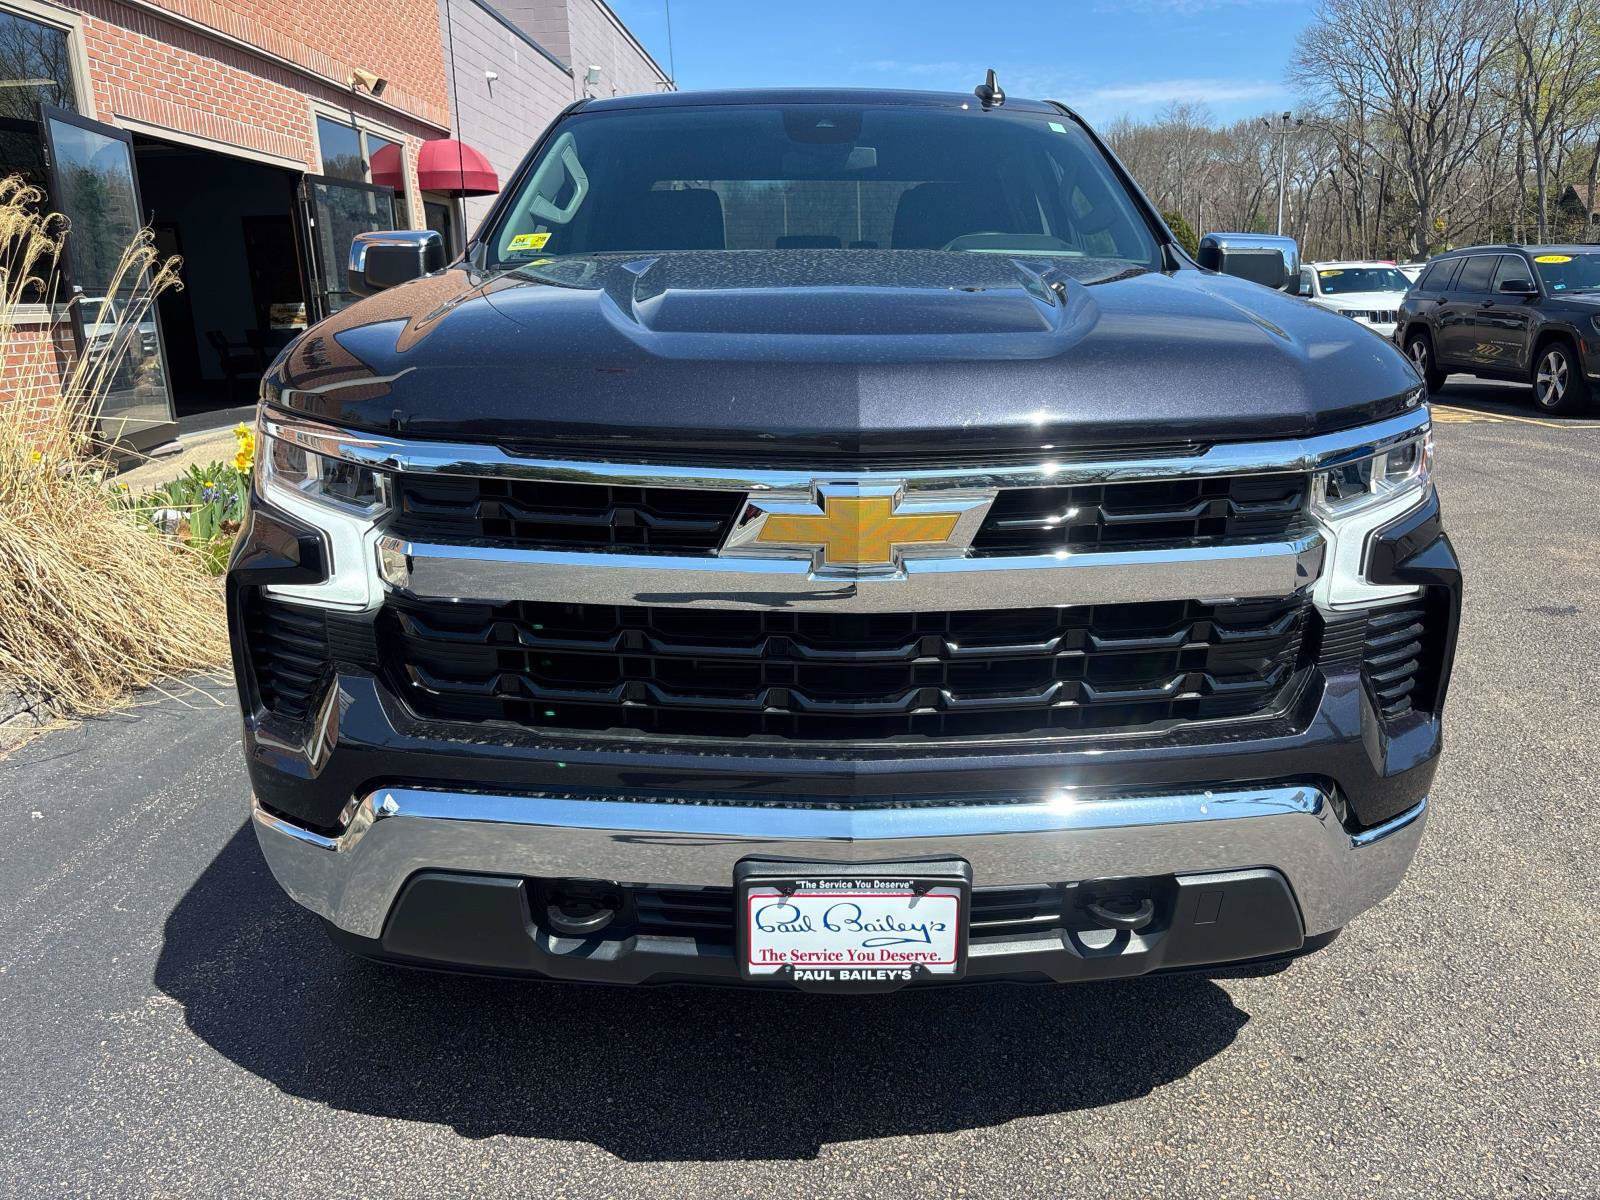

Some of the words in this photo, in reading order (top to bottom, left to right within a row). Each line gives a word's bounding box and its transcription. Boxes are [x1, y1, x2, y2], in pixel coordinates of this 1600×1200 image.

[795, 880, 817, 889] "The
[819, 880, 853, 889] Service
[855, 880, 872, 889] You
[873, 880, 914, 889] Deserve"
[755, 902, 817, 933] Paul
[823, 902, 947, 948] Bailey's
[759, 949, 789, 962] The
[790, 949, 844, 962] Service
[847, 949, 876, 962] You
[880, 949, 942, 962] Deserve.
[794, 970, 835, 981] PAUL
[839, 970, 913, 981] BAILEY'S
